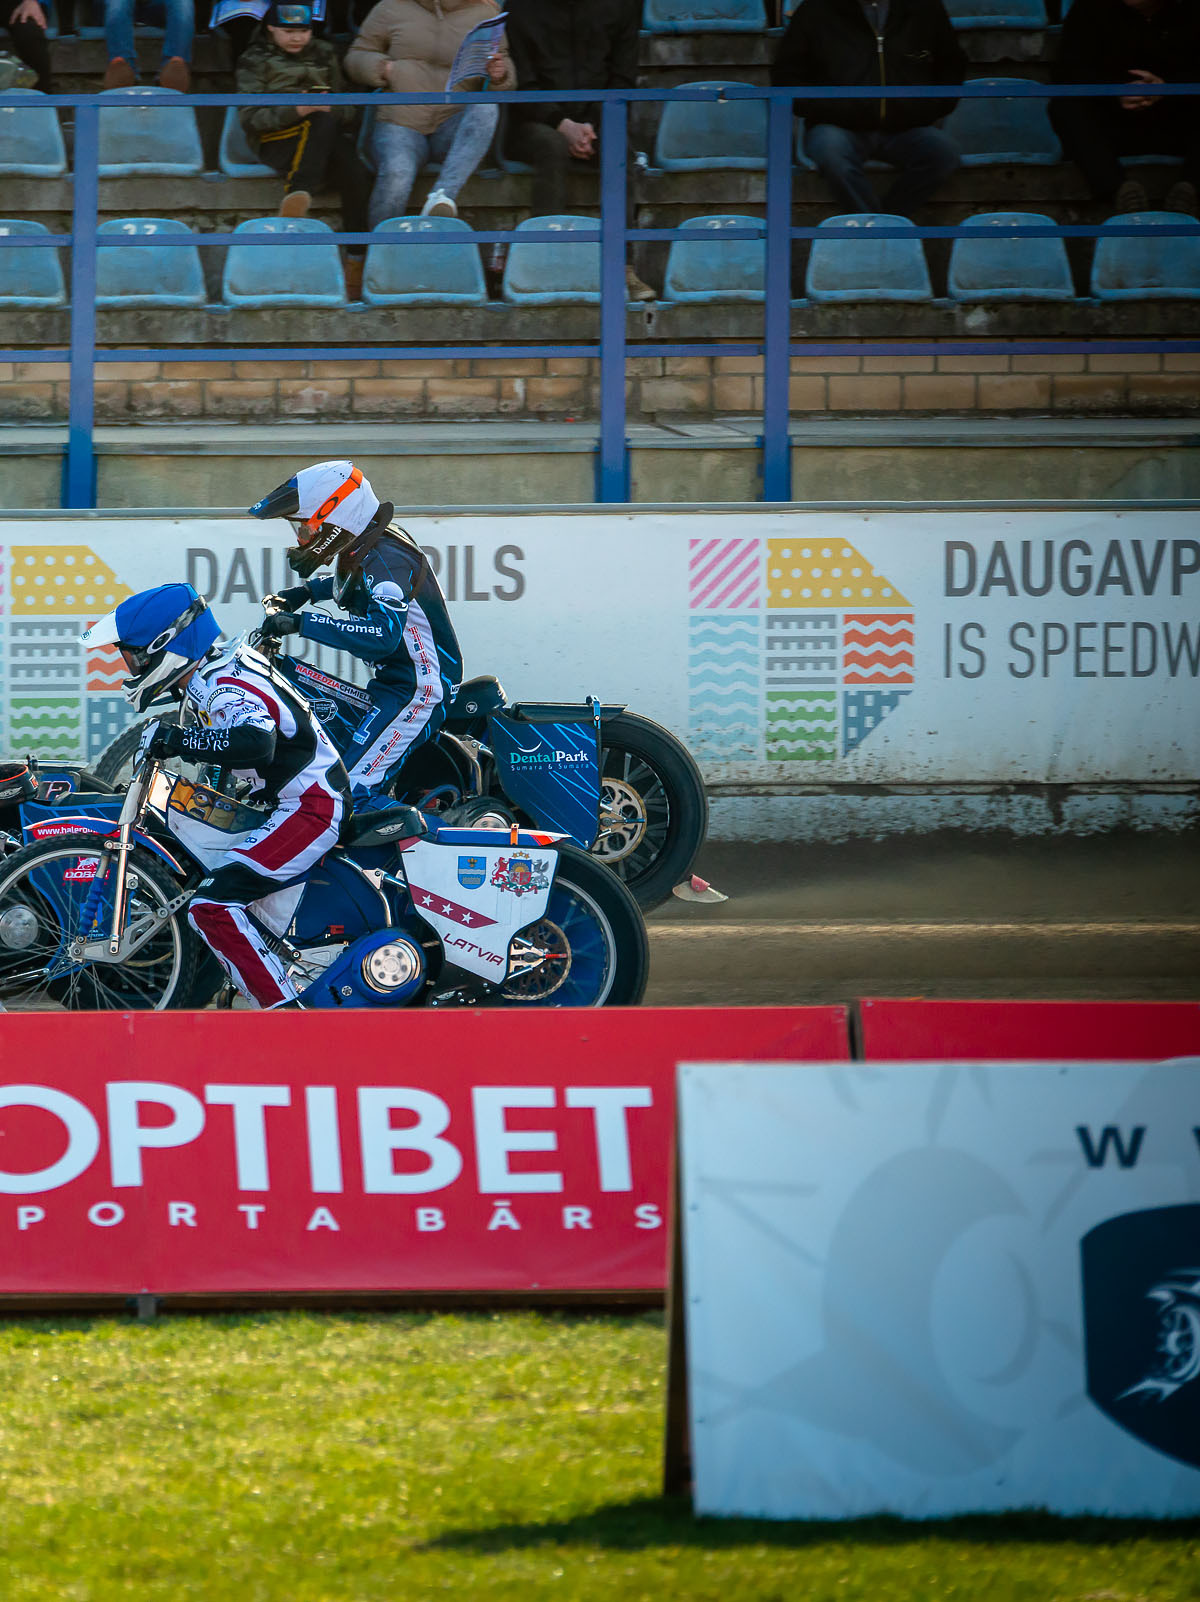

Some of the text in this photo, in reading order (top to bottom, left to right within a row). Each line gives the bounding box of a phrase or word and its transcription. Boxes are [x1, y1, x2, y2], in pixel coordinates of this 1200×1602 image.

[944, 539, 1200, 597] DAUGAVP
[944, 621, 1200, 678] IS SPEEDW
[510, 750, 589, 764] DentalPark
[443, 933, 505, 966] LATVIA
[416, 1200, 662, 1232] BĀRS
